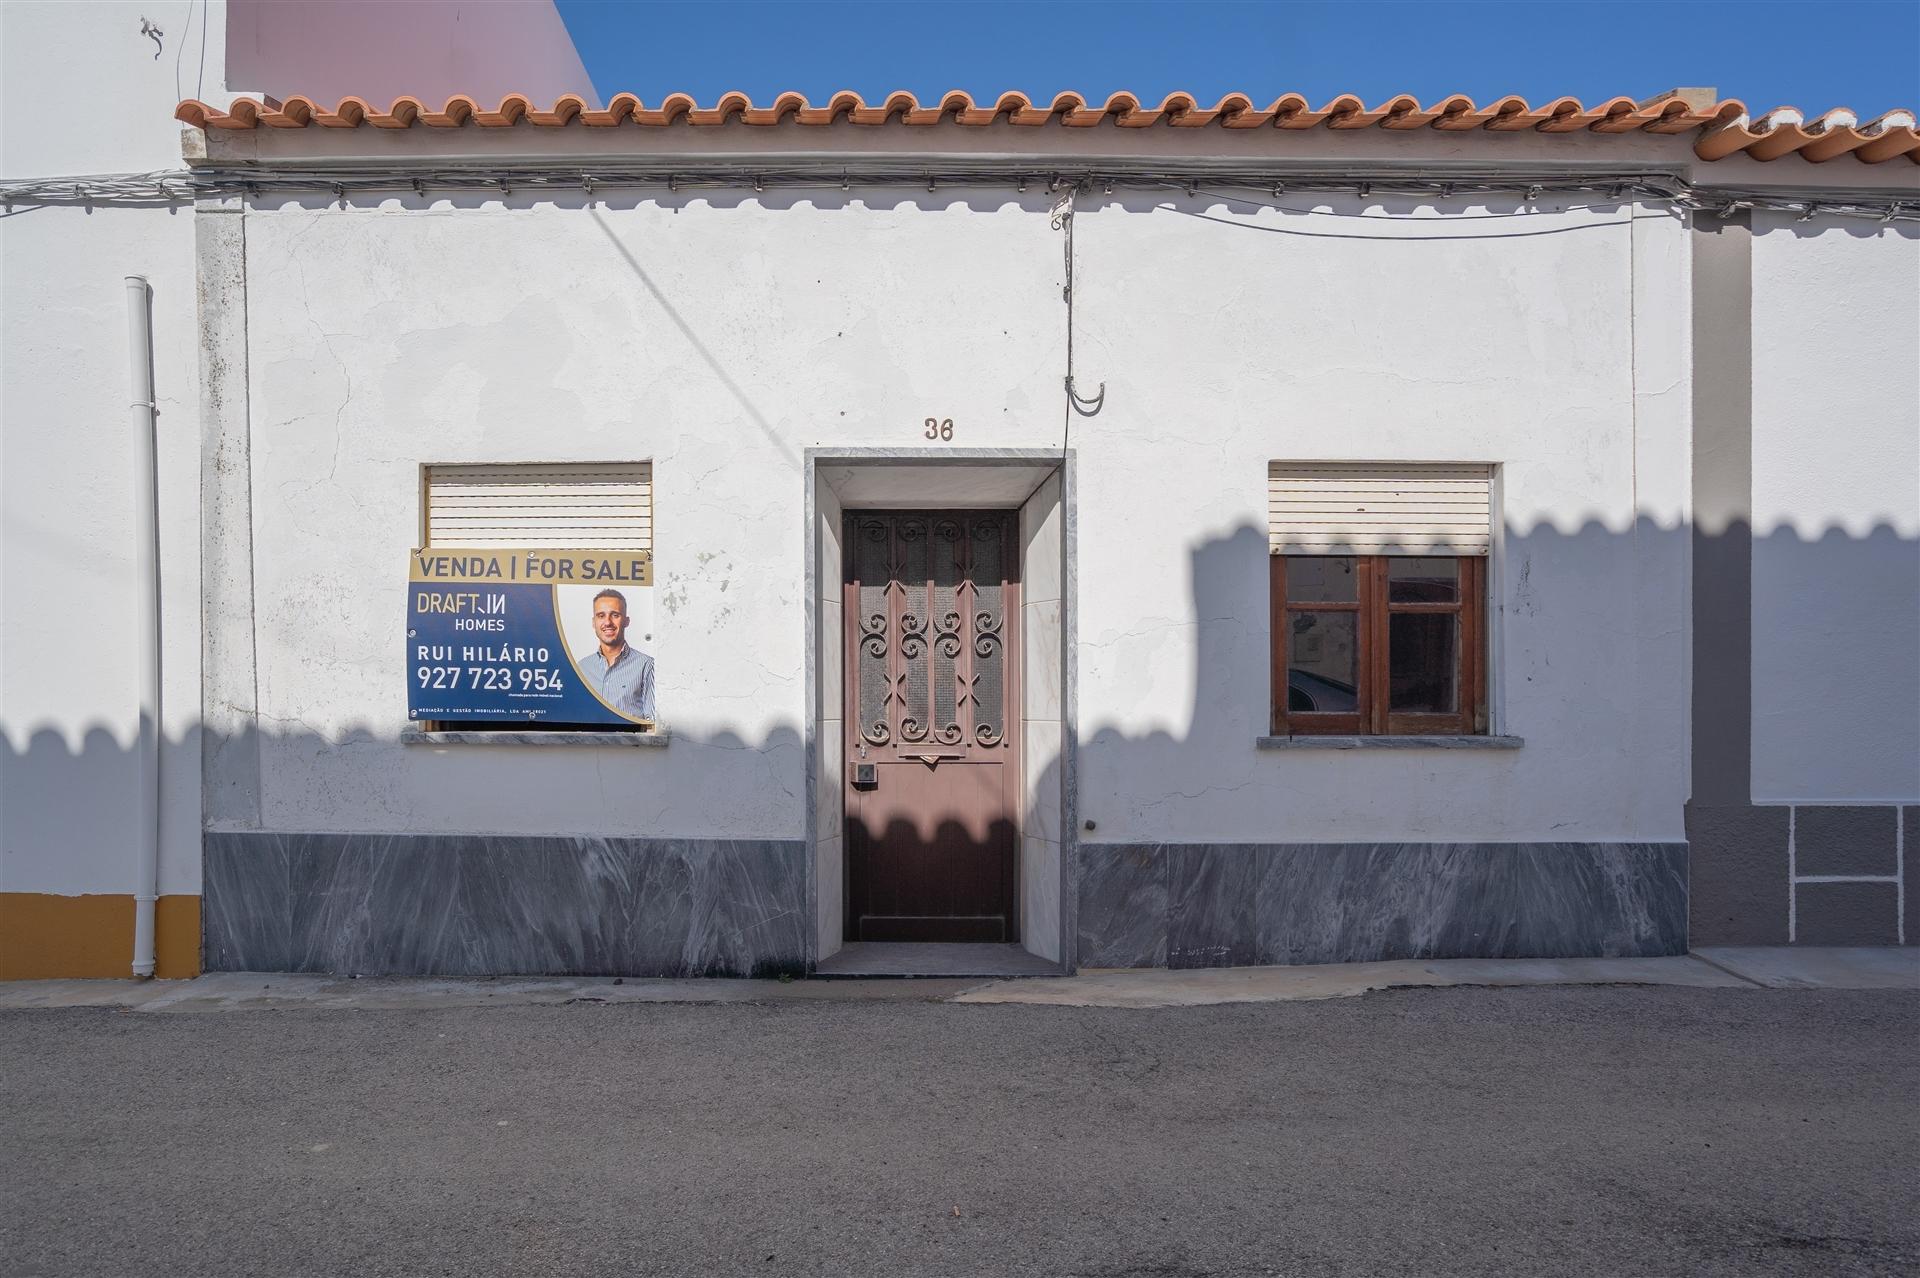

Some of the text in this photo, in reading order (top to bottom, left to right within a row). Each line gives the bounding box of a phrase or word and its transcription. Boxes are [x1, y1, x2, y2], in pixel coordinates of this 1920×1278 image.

[924, 417, 954, 442] 36
[420, 556, 502, 578] VENDA
[526, 558, 574, 579] FOR
[581, 559, 646, 581] SALE
[455, 619, 505, 632] HOMES
[417, 643, 549, 662] RUI HILÁRIO
[417, 667, 564, 691] 927 723 954
